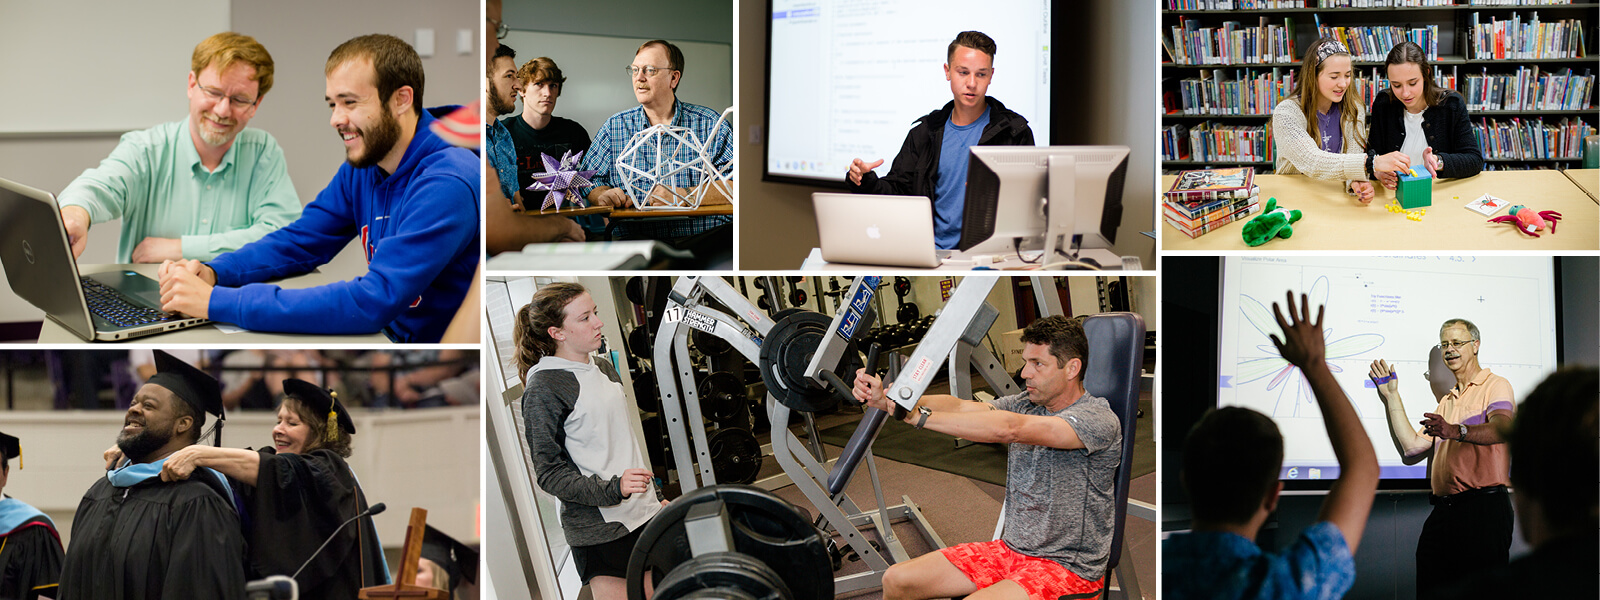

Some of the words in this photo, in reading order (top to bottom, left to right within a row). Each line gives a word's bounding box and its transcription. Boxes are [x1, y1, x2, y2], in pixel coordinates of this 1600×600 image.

[667, 308, 679, 321] 17
[686, 310, 715, 326] HAMMER
[682, 316, 715, 333] STRENGTH
